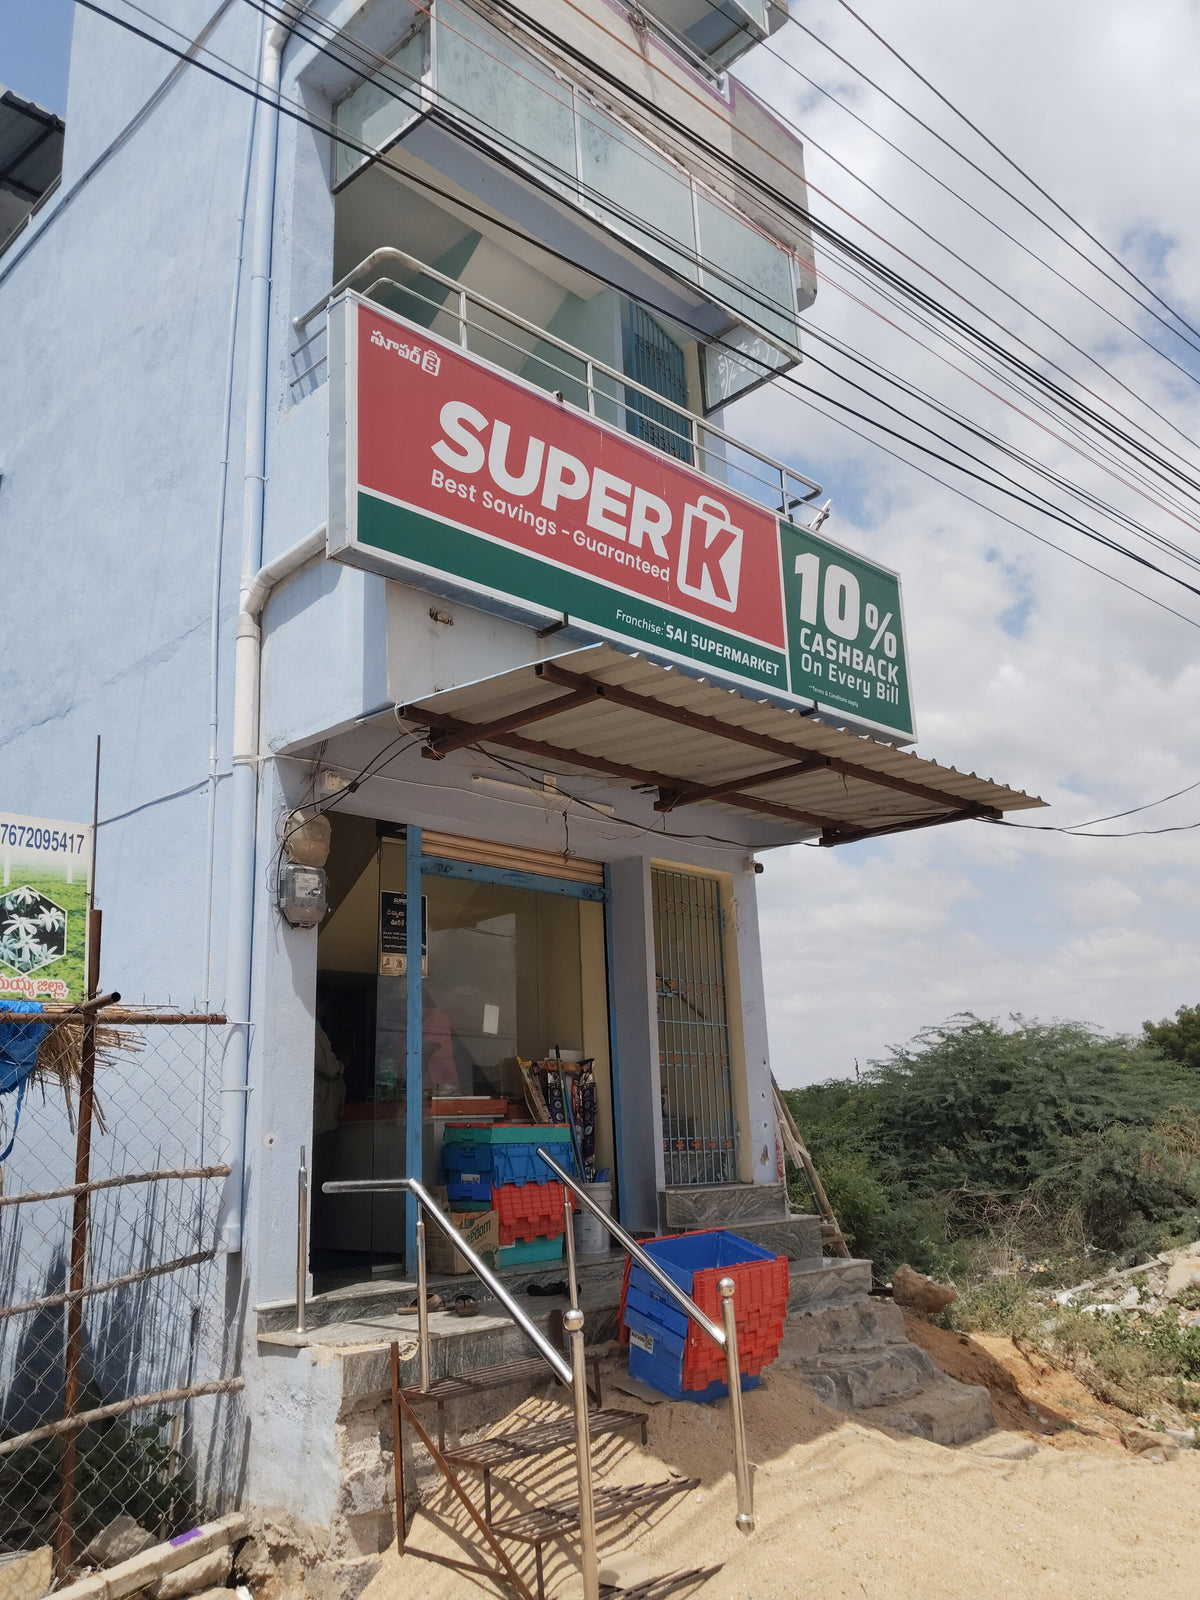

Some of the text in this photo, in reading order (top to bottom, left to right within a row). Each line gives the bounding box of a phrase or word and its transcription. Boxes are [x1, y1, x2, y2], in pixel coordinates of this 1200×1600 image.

[431, 401, 674, 560] SUPER
[431, 469, 476, 503] Best
[482, 490, 557, 536] Savings
[573, 530, 670, 582] Guaranteed
[616, 609, 779, 676] Franchise: SAI SUPERMARKET
[800, 627, 899, 686] CASHBACK
[801, 653, 899, 705] On Every Bill
[1, 823, 84, 854] 7672095417
